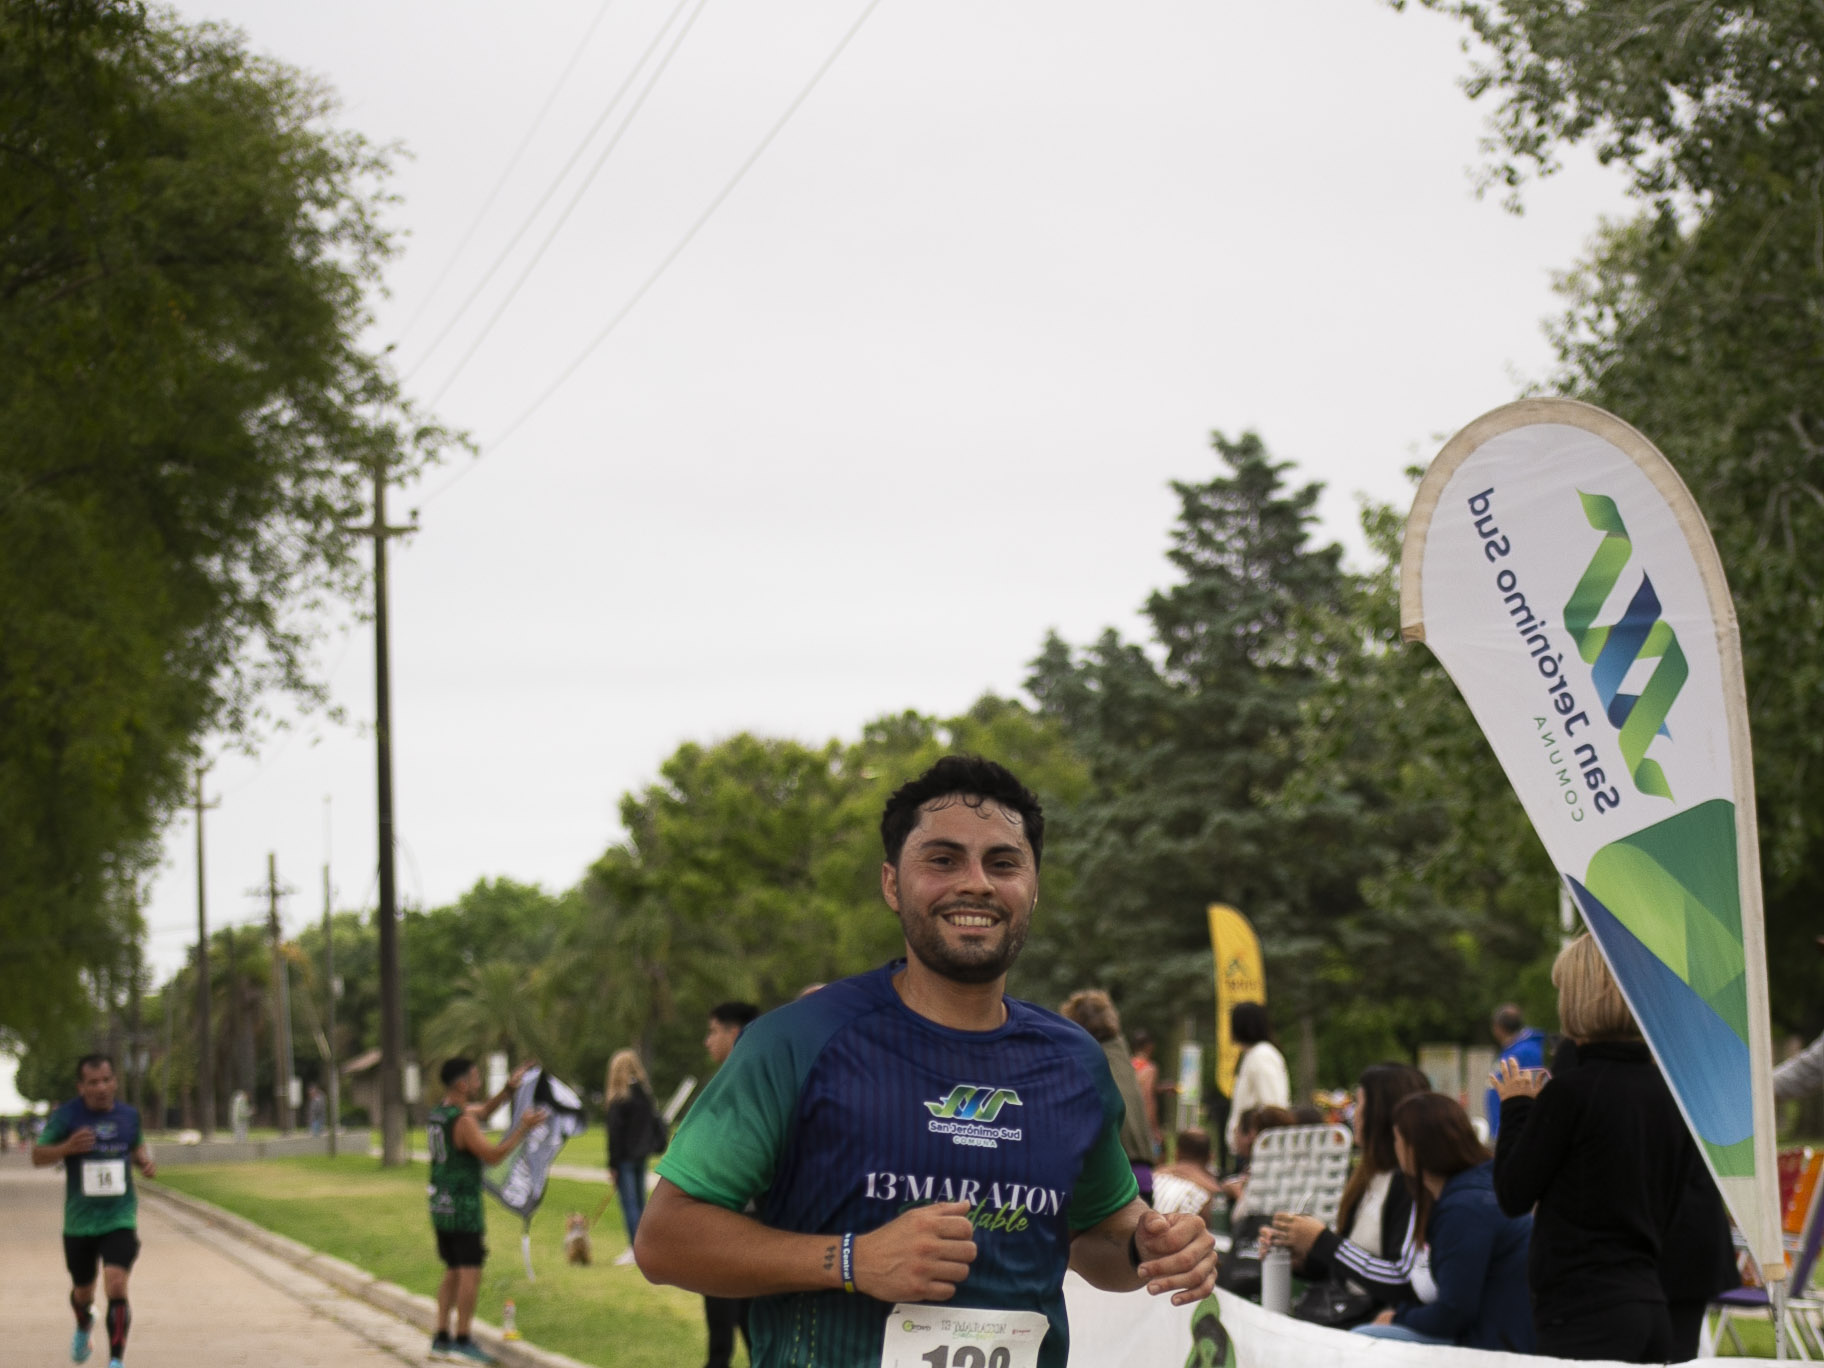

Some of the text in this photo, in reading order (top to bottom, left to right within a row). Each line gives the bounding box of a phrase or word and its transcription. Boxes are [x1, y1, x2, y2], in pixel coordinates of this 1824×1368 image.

[929, 1121, 950, 1133] San
[1000, 1128, 1021, 1140] Sud
[953, 1136, 997, 1148] COMUNA
